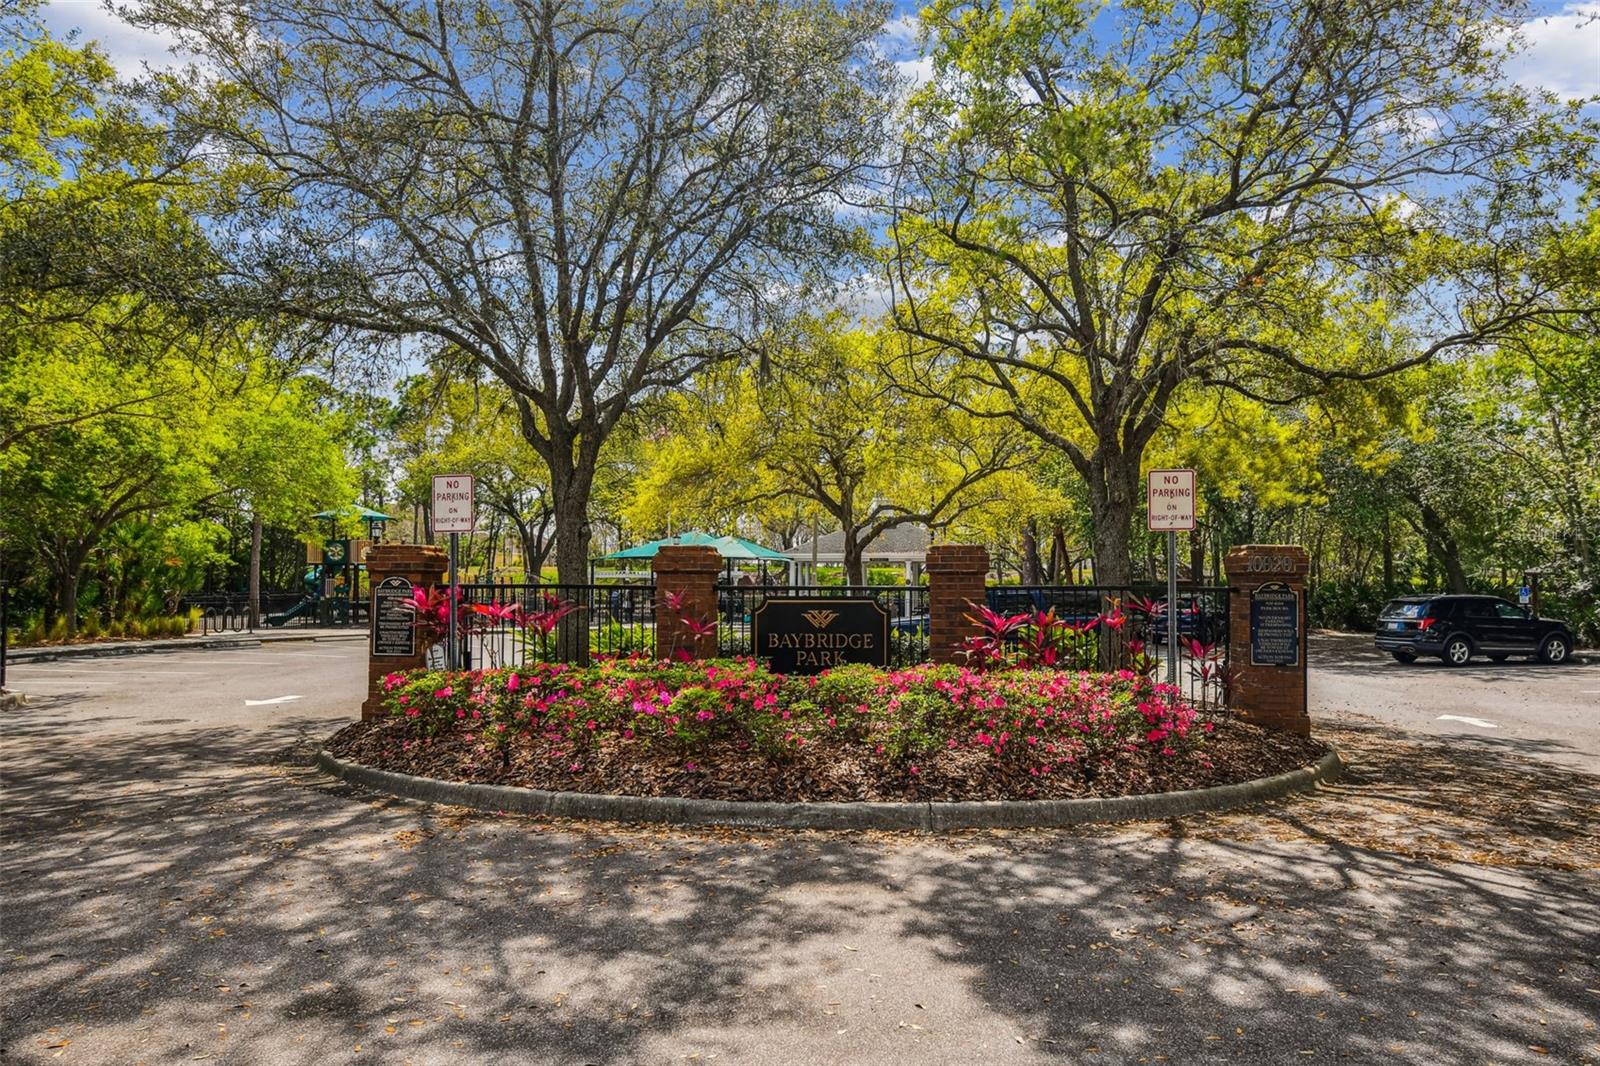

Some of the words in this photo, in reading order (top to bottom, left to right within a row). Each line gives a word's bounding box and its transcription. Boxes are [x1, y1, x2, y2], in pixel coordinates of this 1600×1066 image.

[446, 480, 460, 489] NO
[1163, 475, 1179, 485] NO
[436, 492, 470, 501] PARKING
[1152, 488, 1191, 497] PARKING
[768, 633, 874, 649] BAYBRIDGE
[796, 651, 847, 666] PARK
